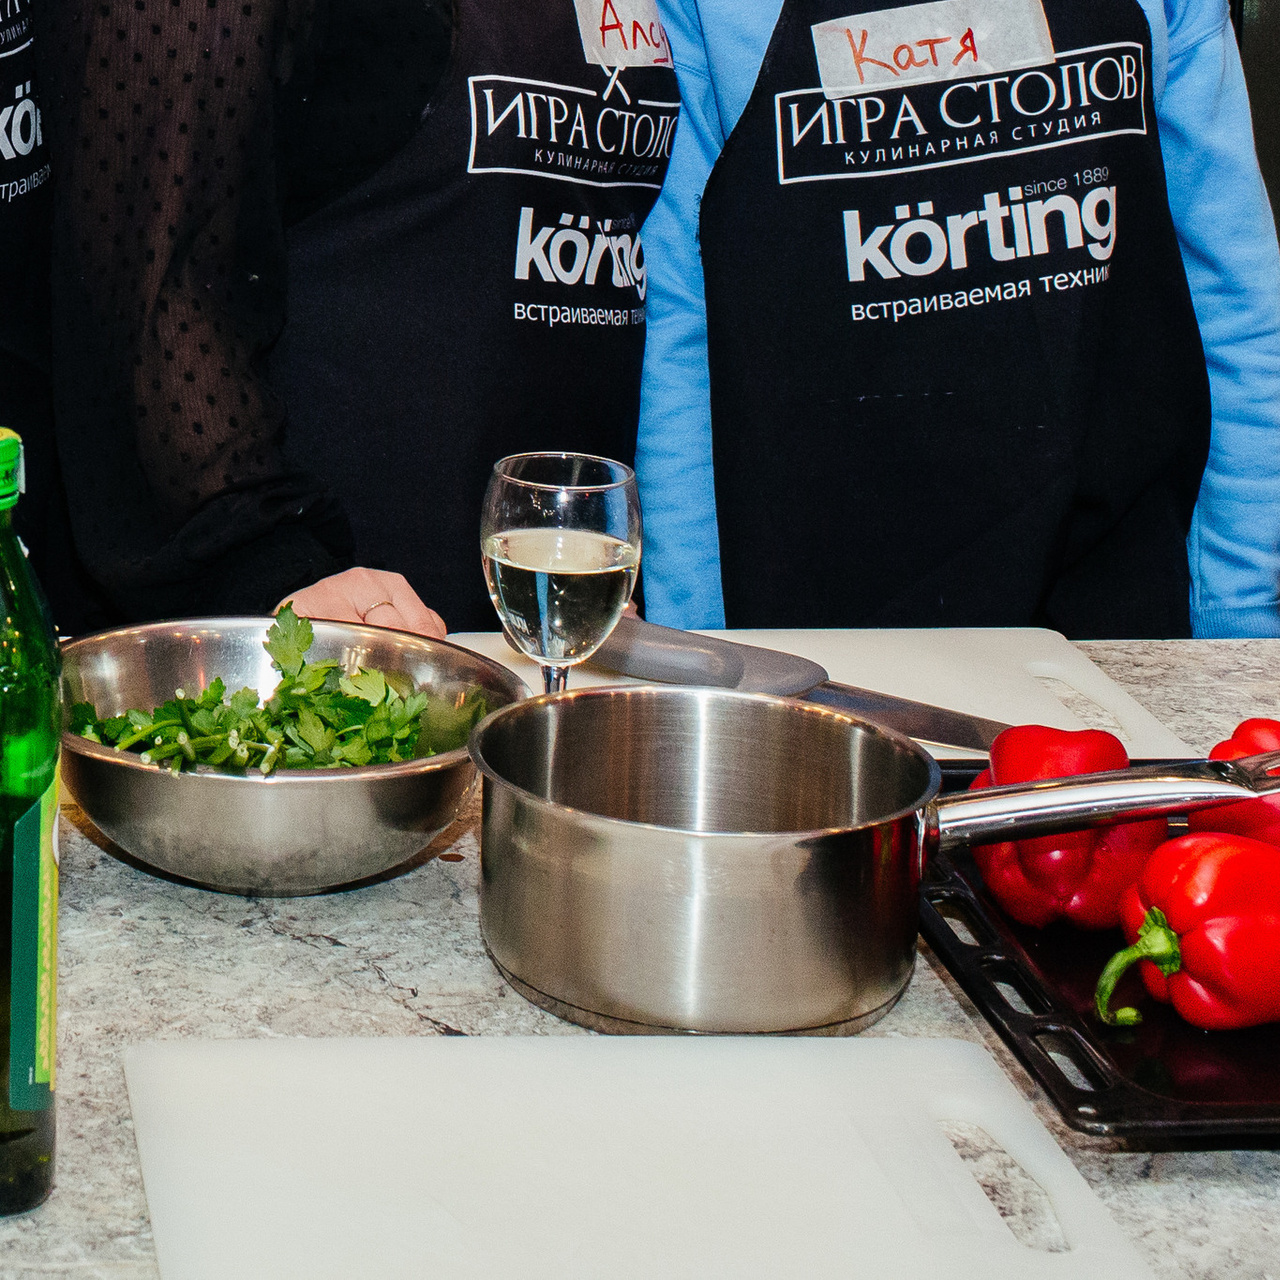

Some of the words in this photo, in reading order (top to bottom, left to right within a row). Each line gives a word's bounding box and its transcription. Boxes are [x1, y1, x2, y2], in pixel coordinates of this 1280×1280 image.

[845, 28, 978, 84] Катя
[483, 89, 590, 150] ИГРА
[789, 94, 929, 147] ИГРА
[939, 54, 1139, 129] СТОЛОВ
[844, 130, 999, 166] КУЛИНАРНАЯ
[1011, 111, 1102, 141] СТУДИЯ
[1024, 177, 1067, 196] since
[1073, 166, 1110, 187] 1889
[842, 185, 1117, 283] körting
[514, 302, 629, 328] встраиваемая
[851, 278, 1032, 323] встраиваемая
